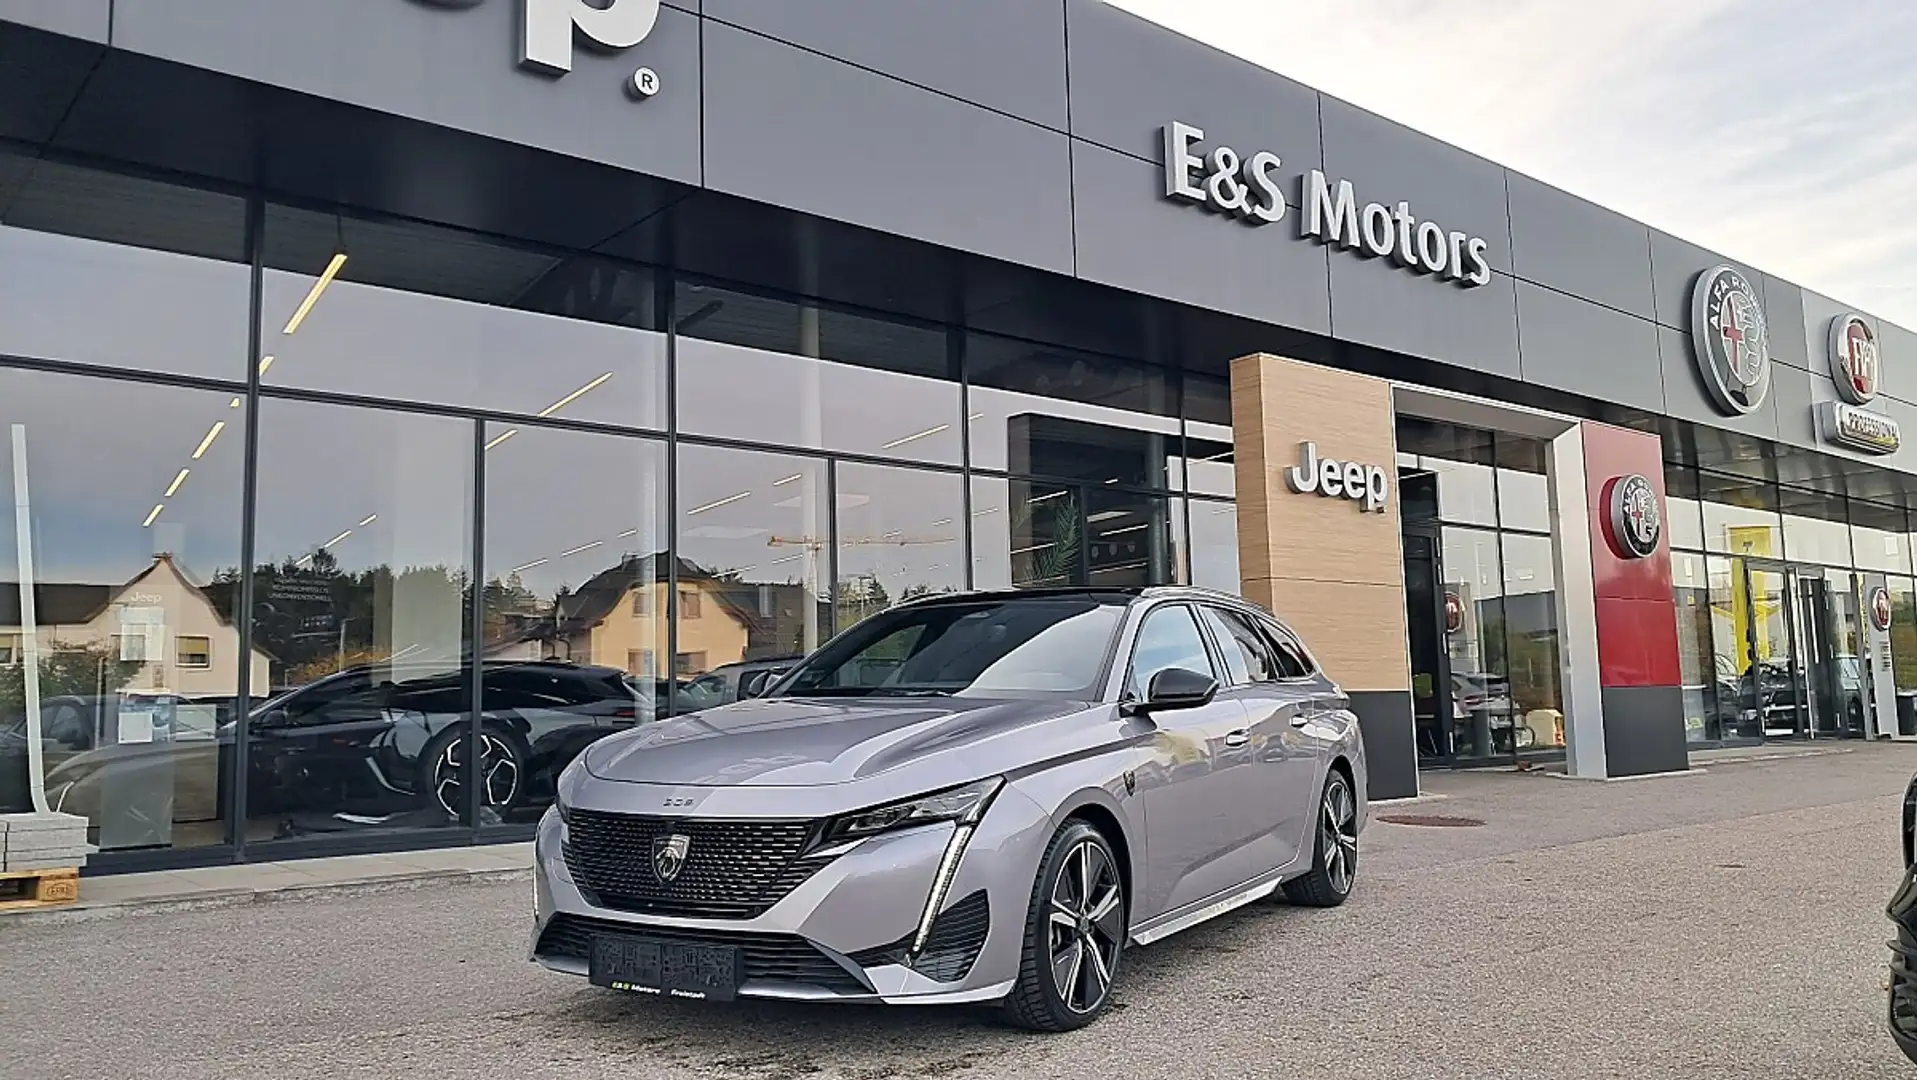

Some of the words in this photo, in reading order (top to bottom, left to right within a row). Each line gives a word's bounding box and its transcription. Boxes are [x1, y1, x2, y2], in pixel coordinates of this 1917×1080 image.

[1164, 121, 1286, 223] E&S
[1300, 170, 1491, 286] Motors
[1710, 279, 1729, 330] ALFA
[1285, 440, 1387, 511] Jeep
[130, 591, 162, 605] Jeep
